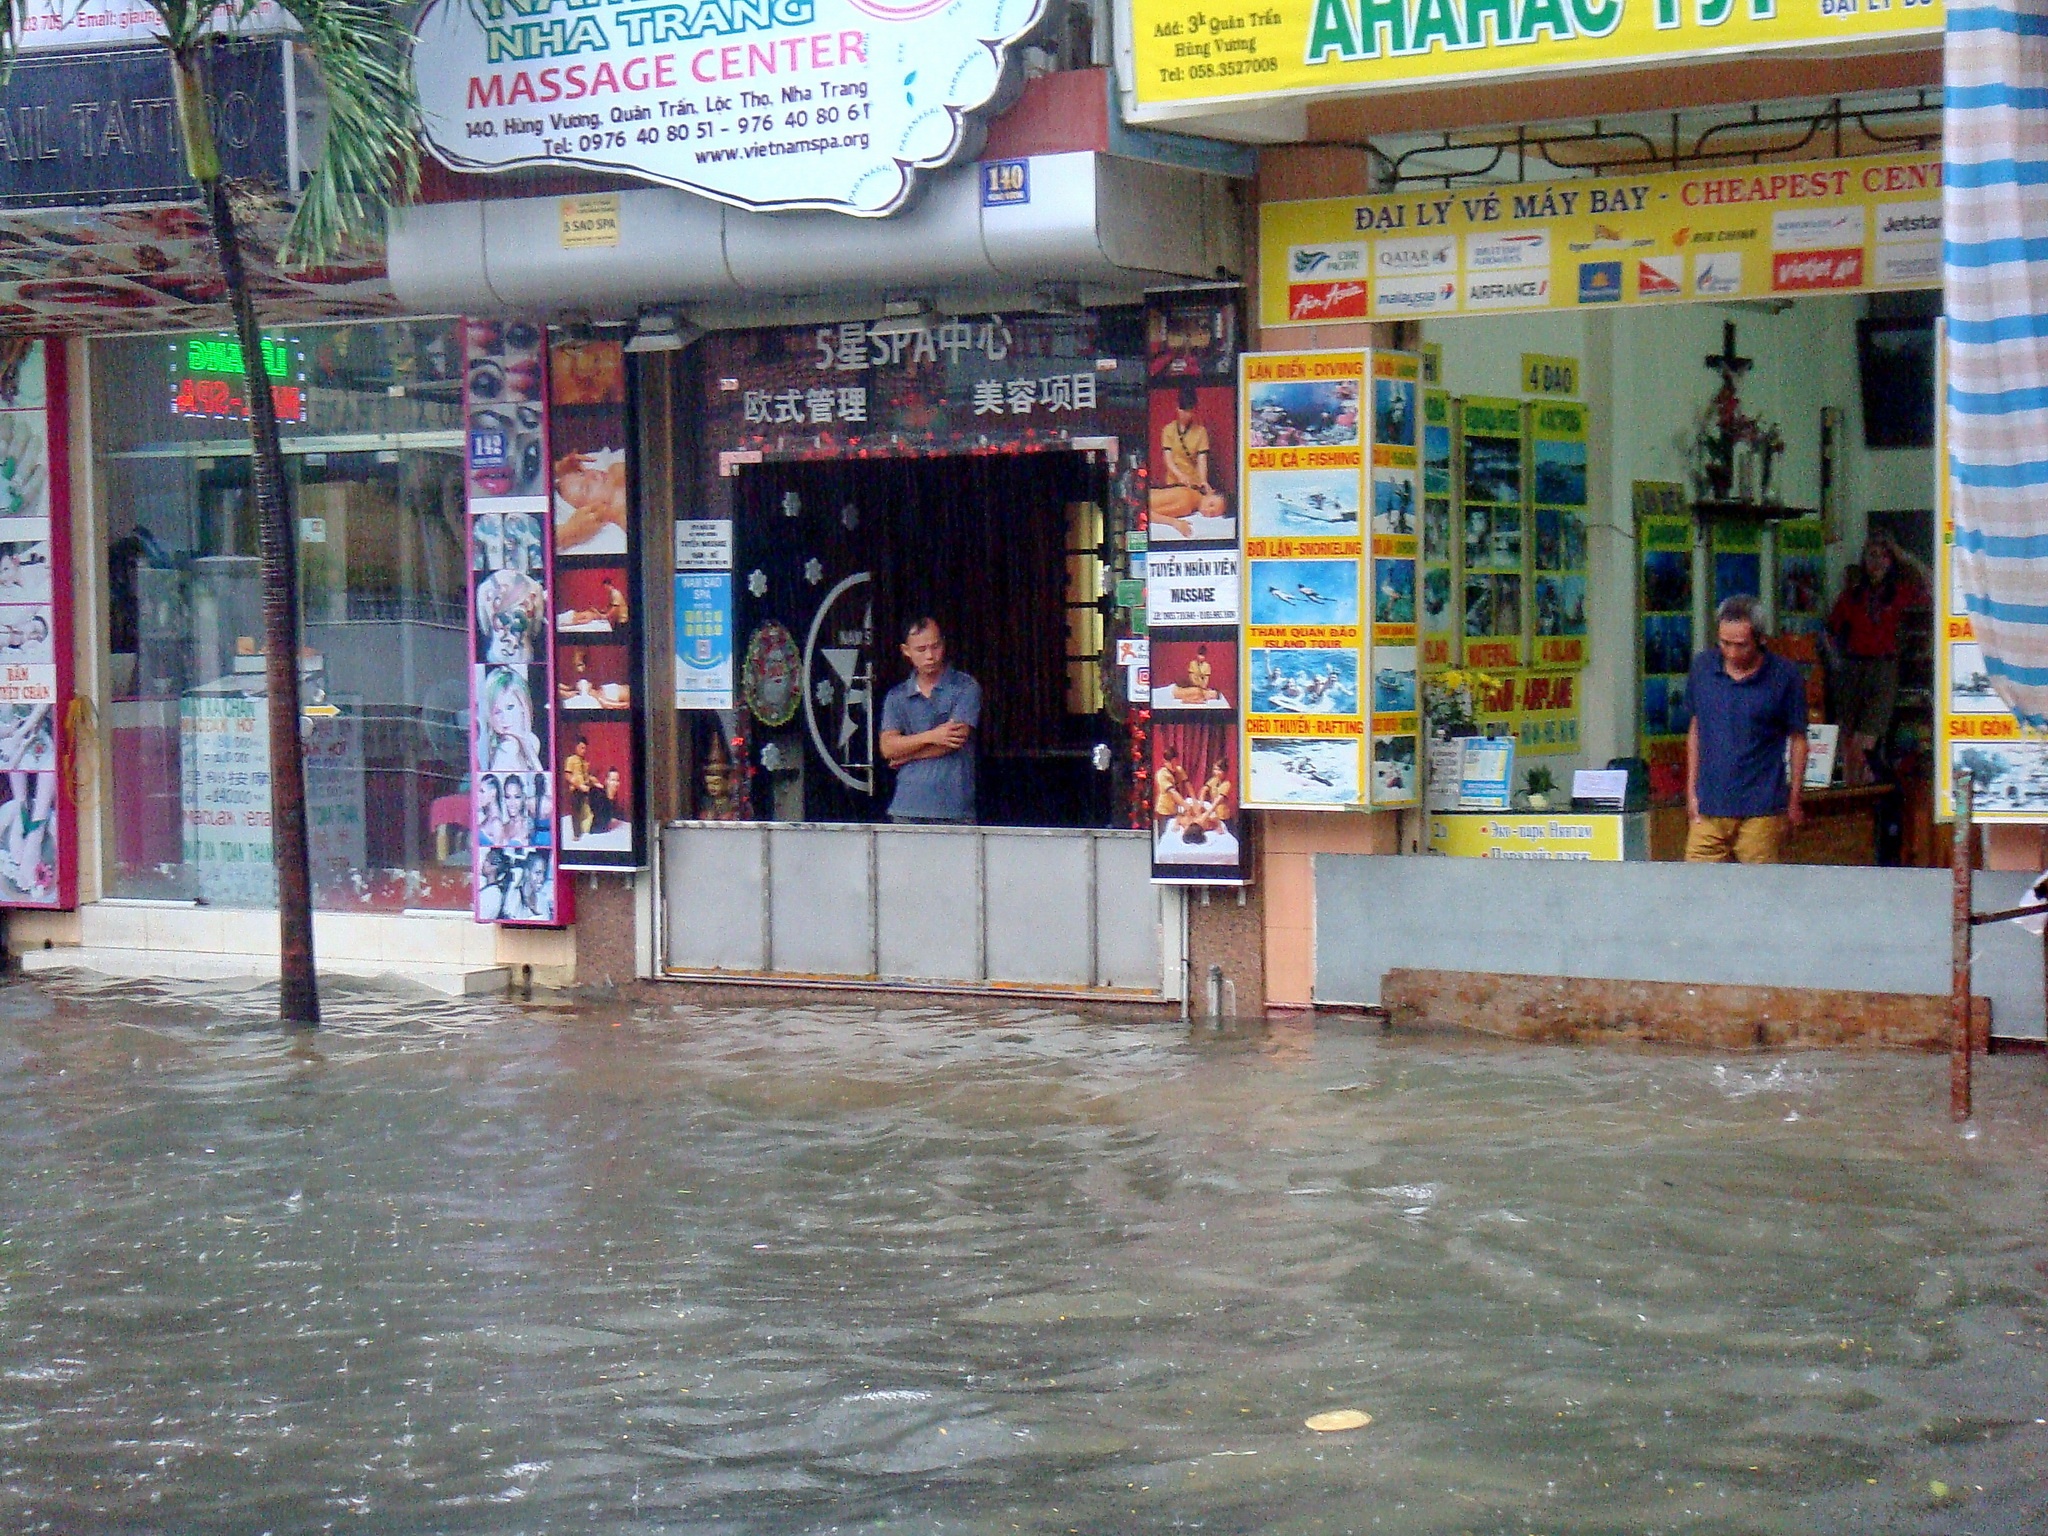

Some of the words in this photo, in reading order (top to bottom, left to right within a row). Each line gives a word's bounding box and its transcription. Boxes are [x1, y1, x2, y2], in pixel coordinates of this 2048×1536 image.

[77, 9, 116, 29] Email:
[487, 14, 610, 64] NHA
[615, 0, 816, 47] TRANG
[1154, 22, 1184, 37] Add:
[467, 54, 678, 110] MASSAGE
[691, 30, 868, 83] CENTER
[1160, 67, 1184, 82] Tel:
[1189, 57, 1278, 79] 058.3527008
[504, 116, 545, 137] Hùng
[610, 105, 652, 124] Quân
[706, 95, 733, 115] Lộc
[782, 86, 812, 104] Nha
[820, 81, 868, 99] Trang
[543, 137, 573, 157] Tel:
[580, 131, 626, 153] 0976
[636, 126, 660, 146] 40
[666, 123, 690, 142] 80
[697, 120, 714, 139] 51
[738, 114, 773, 134] 976
[785, 110, 808, 129] 40
[816, 106, 839, 125] 80
[695, 133, 869, 164] www.vietnamspa.org
[989, 165, 1024, 191] 140
[1355, 204, 1405, 234] ĐẠI
[1416, 196, 1454, 227] LÝ
[1463, 192, 1501, 222] VÉ
[1513, 187, 1579, 220] MÁY
[1590, 186, 1650, 214] BAY
[1681, 171, 1849, 207] CHEAPEST
[1381, 250, 1430, 267] QATAR
[1314, 361, 1363, 377] DIVING
[973, 372, 1097, 416] 美容项目
[744, 387, 868, 424] 欧式管理
[1307, 452, 1361, 467] FISHING
[1185, 558, 1212, 577] NHÂN
[1214, 557, 1237, 576] VIÊN
[694, 589, 711, 600] SPA
[1171, 588, 1215, 603] MASSAGE
[1250, 628, 1287, 638] THAM
[1290, 627, 1326, 639] QUAN
[1264, 639, 1306, 648] ISLAND
[1310, 639, 1342, 648] TOUR
[1317, 720, 1364, 735] RAFTING
